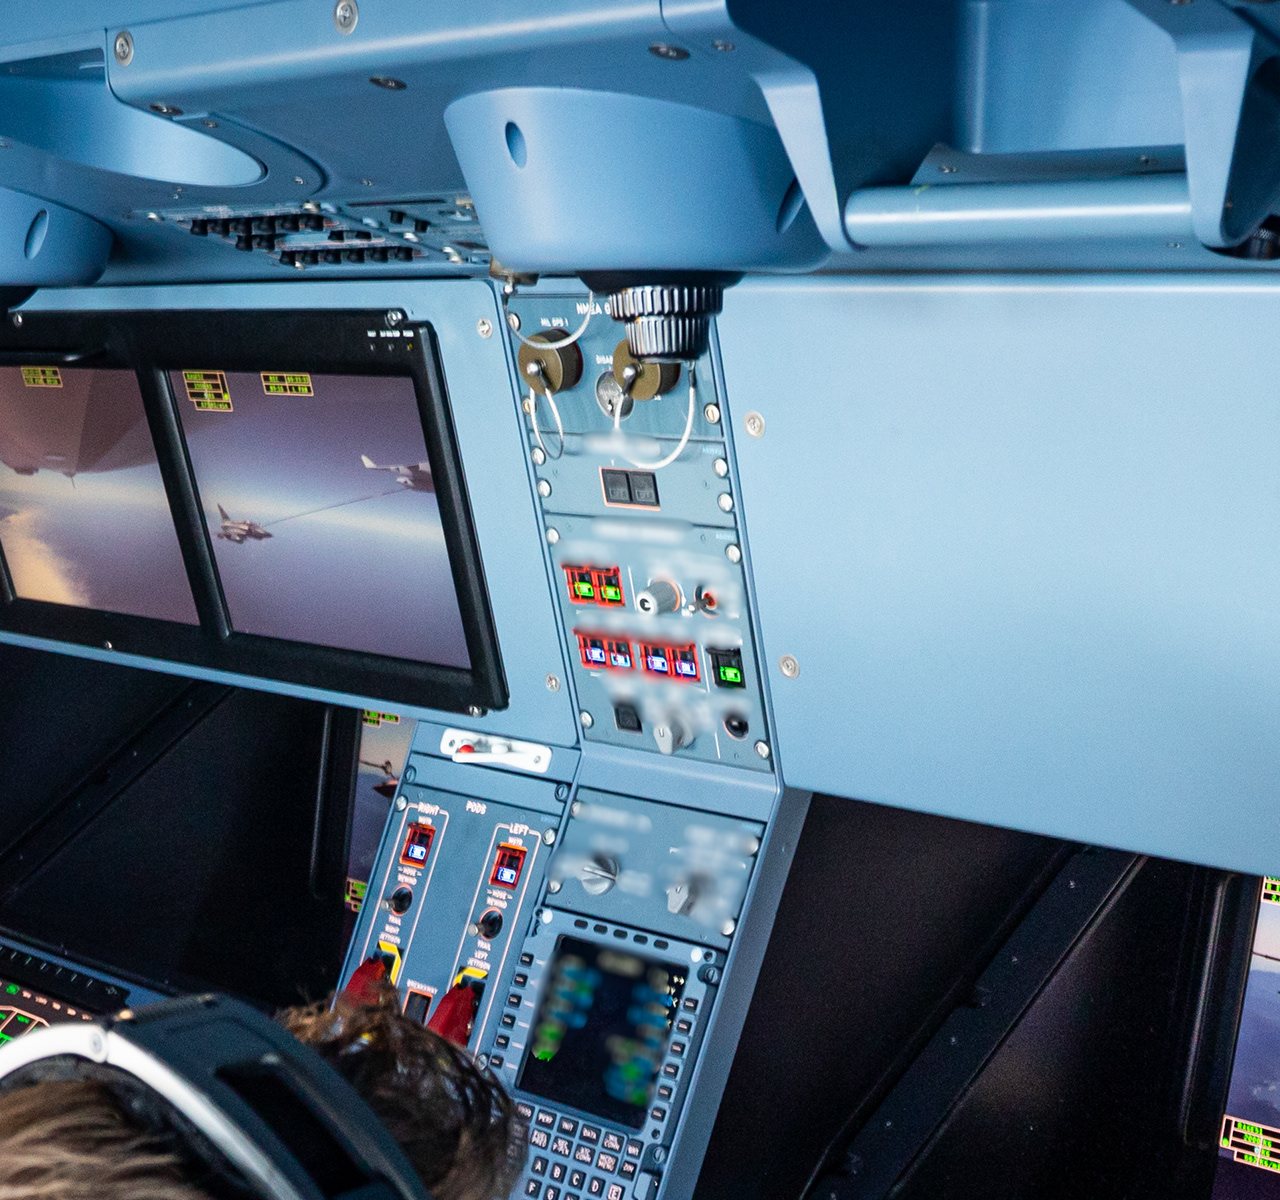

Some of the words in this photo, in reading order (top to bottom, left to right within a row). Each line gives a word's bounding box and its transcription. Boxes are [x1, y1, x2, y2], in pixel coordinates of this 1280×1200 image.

[418, 802, 440, 816] RIGHT
[466, 800, 487, 815] PODS
[509, 823, 530, 836] LEFT
[535, 1160, 542, 1172] A
[553, 1165, 561, 1178] B
[573, 1173, 580, 1185] C
[529, 1181, 536, 1193] F
[591, 1180, 599, 1192] D
[547, 1188, 555, 1200] G
